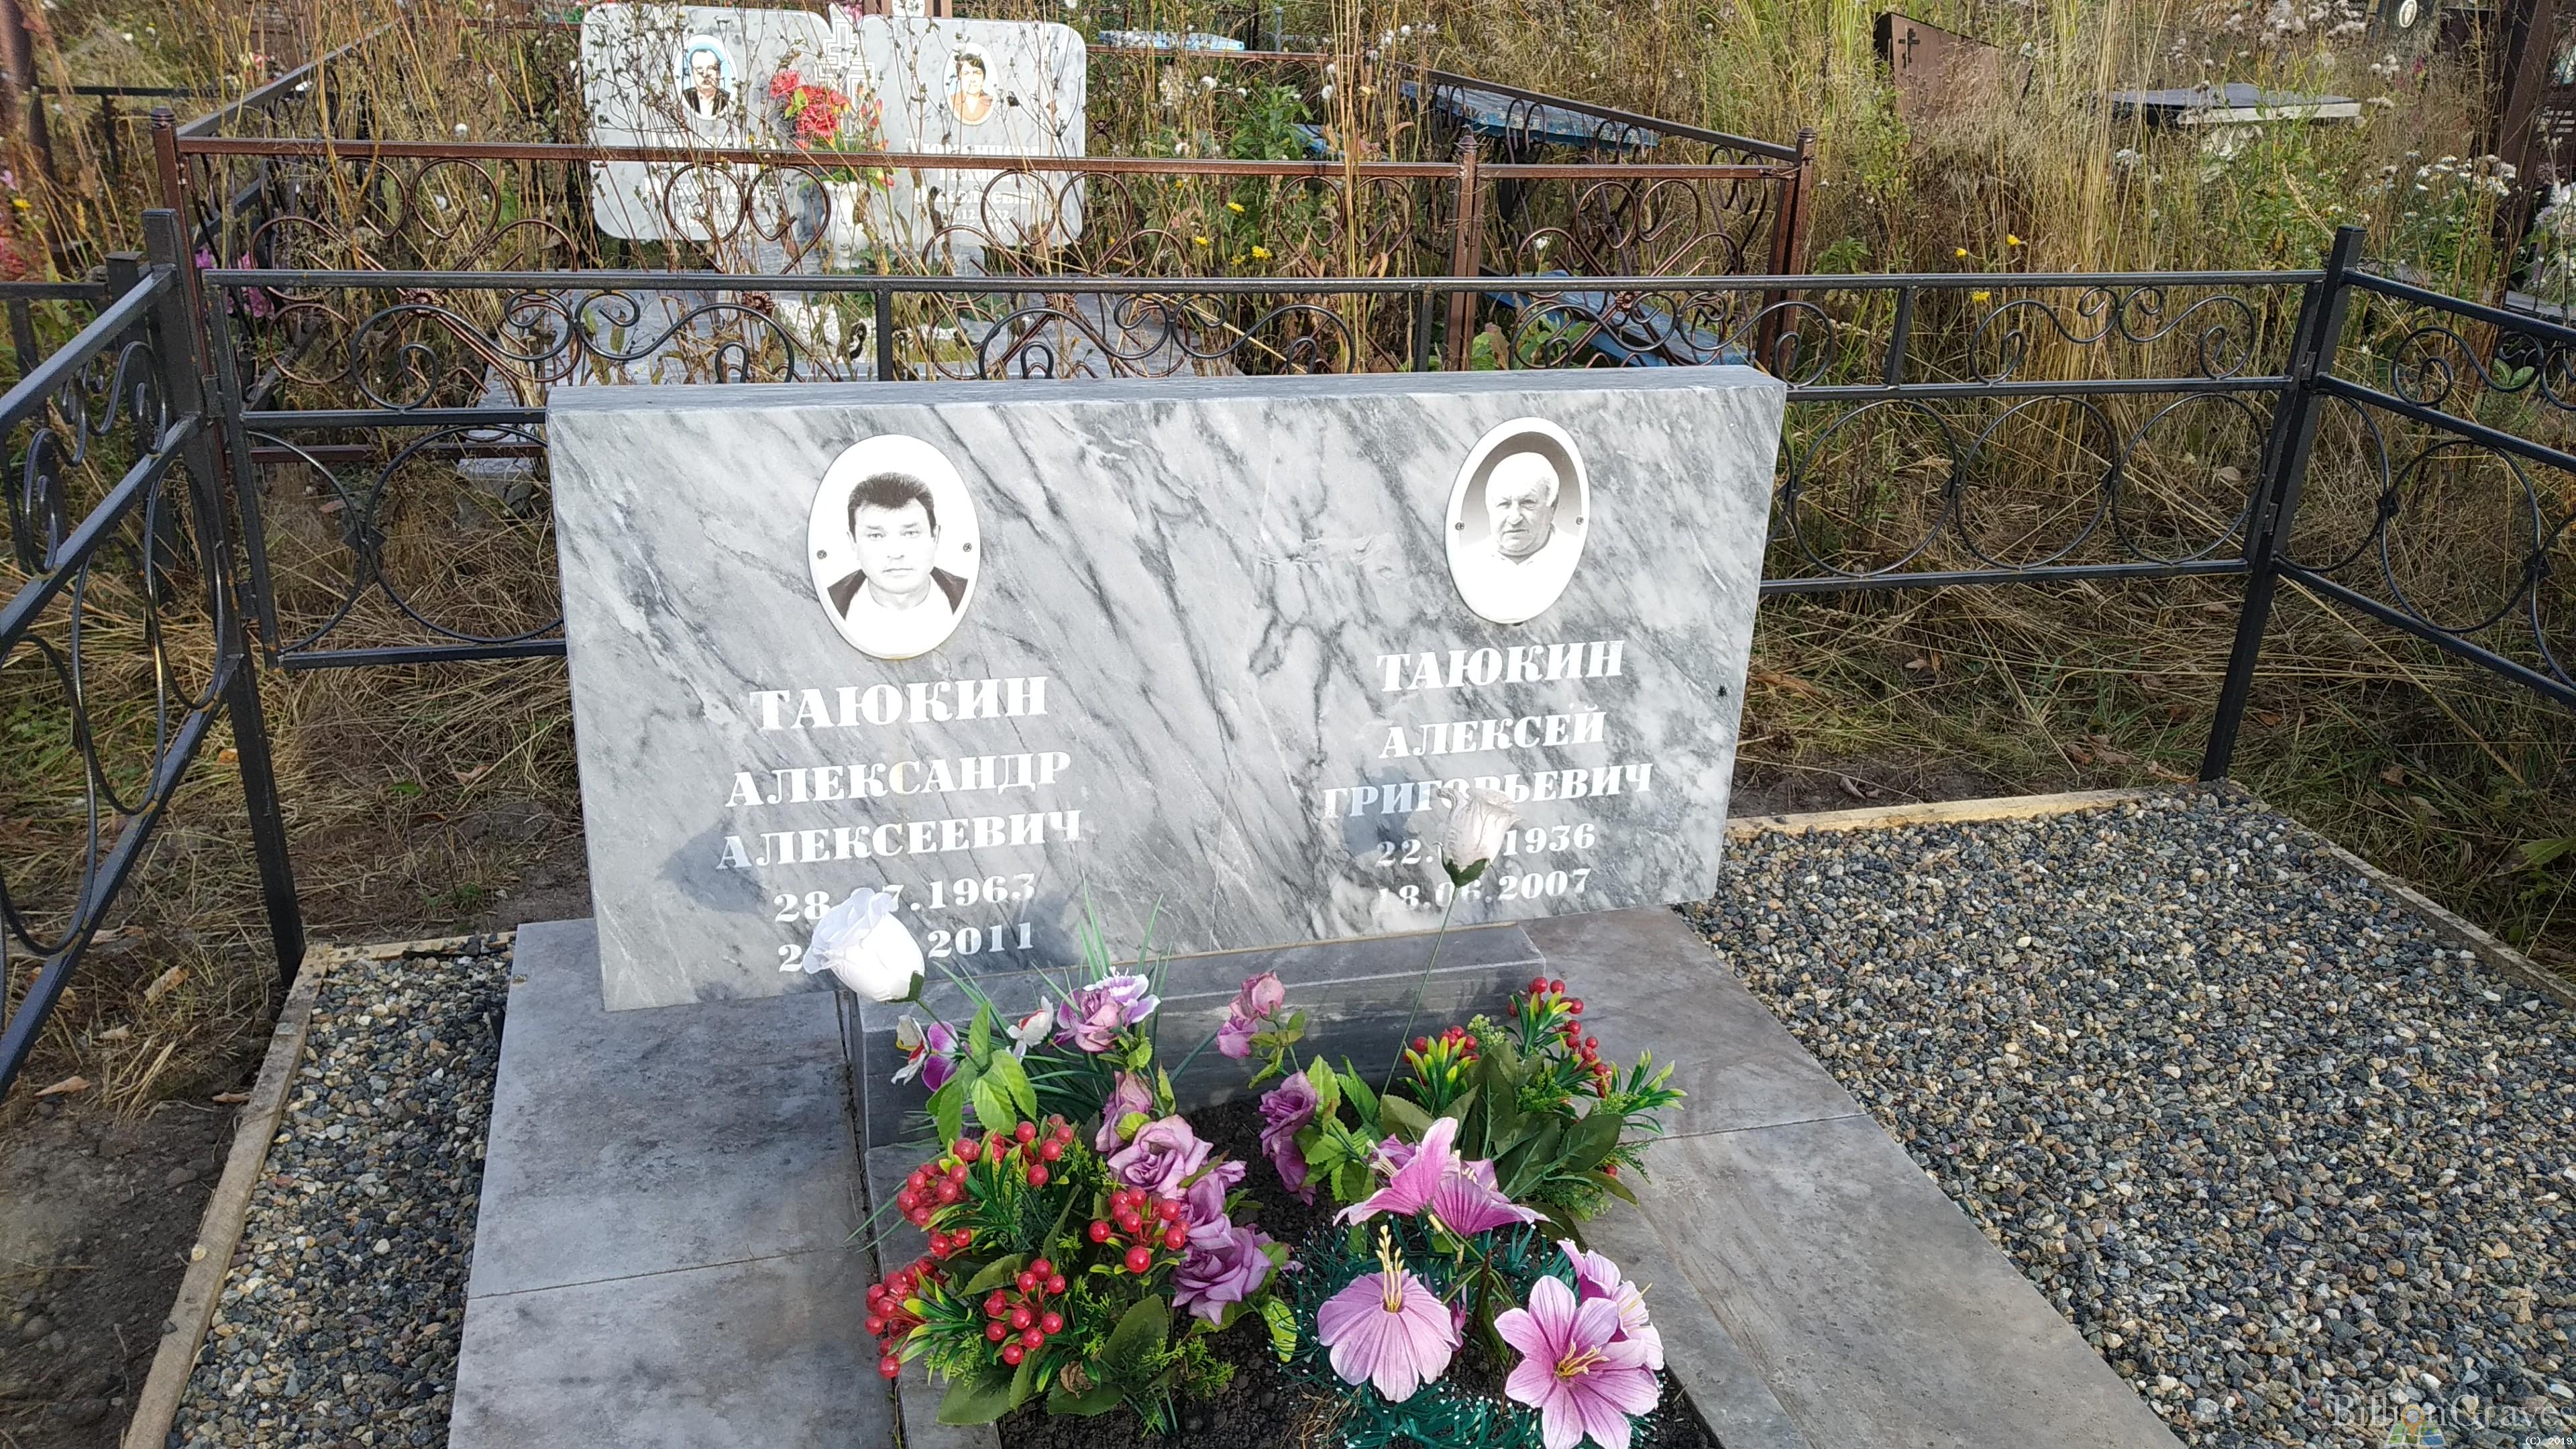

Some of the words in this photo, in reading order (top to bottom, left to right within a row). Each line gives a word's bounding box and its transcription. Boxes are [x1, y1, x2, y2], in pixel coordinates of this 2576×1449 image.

[1376, 640, 1625, 692] ТАЮКИН
[749, 676, 1049, 730] ТАЮКИН
[1378, 703, 1607, 759] АЛЕКСЕЙ
[724, 751, 1071, 807] АЛЕКСАНДР
[715, 810, 1085, 870] АЛЕКСЕЕВИЧ
